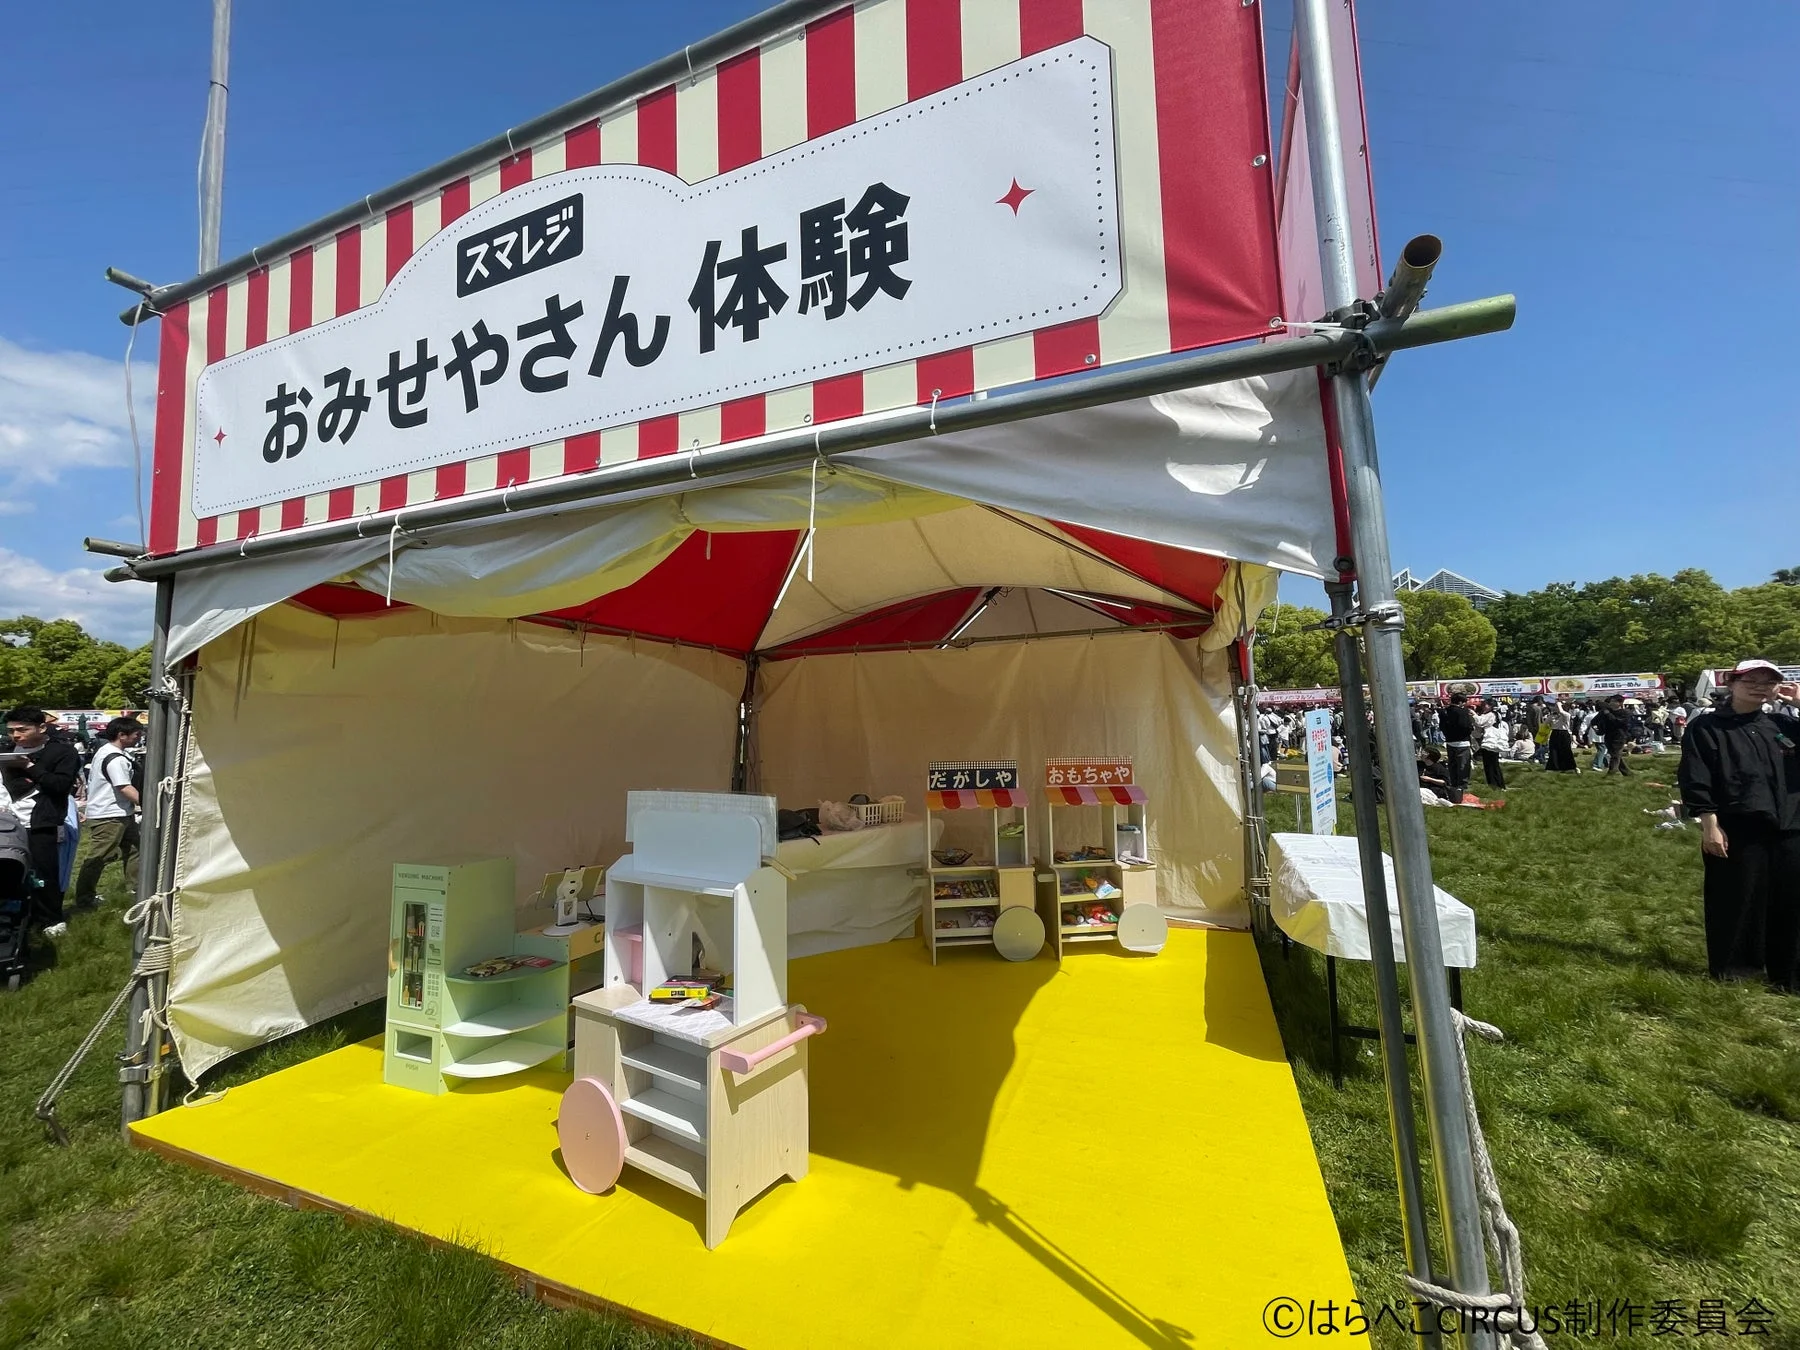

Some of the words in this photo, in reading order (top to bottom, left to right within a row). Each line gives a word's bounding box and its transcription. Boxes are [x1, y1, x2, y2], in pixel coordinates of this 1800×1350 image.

[465, 205, 575, 285] スマレジ
[930, 770, 1012, 789] だがしや
[1048, 766, 1130, 784] おもちゃや
